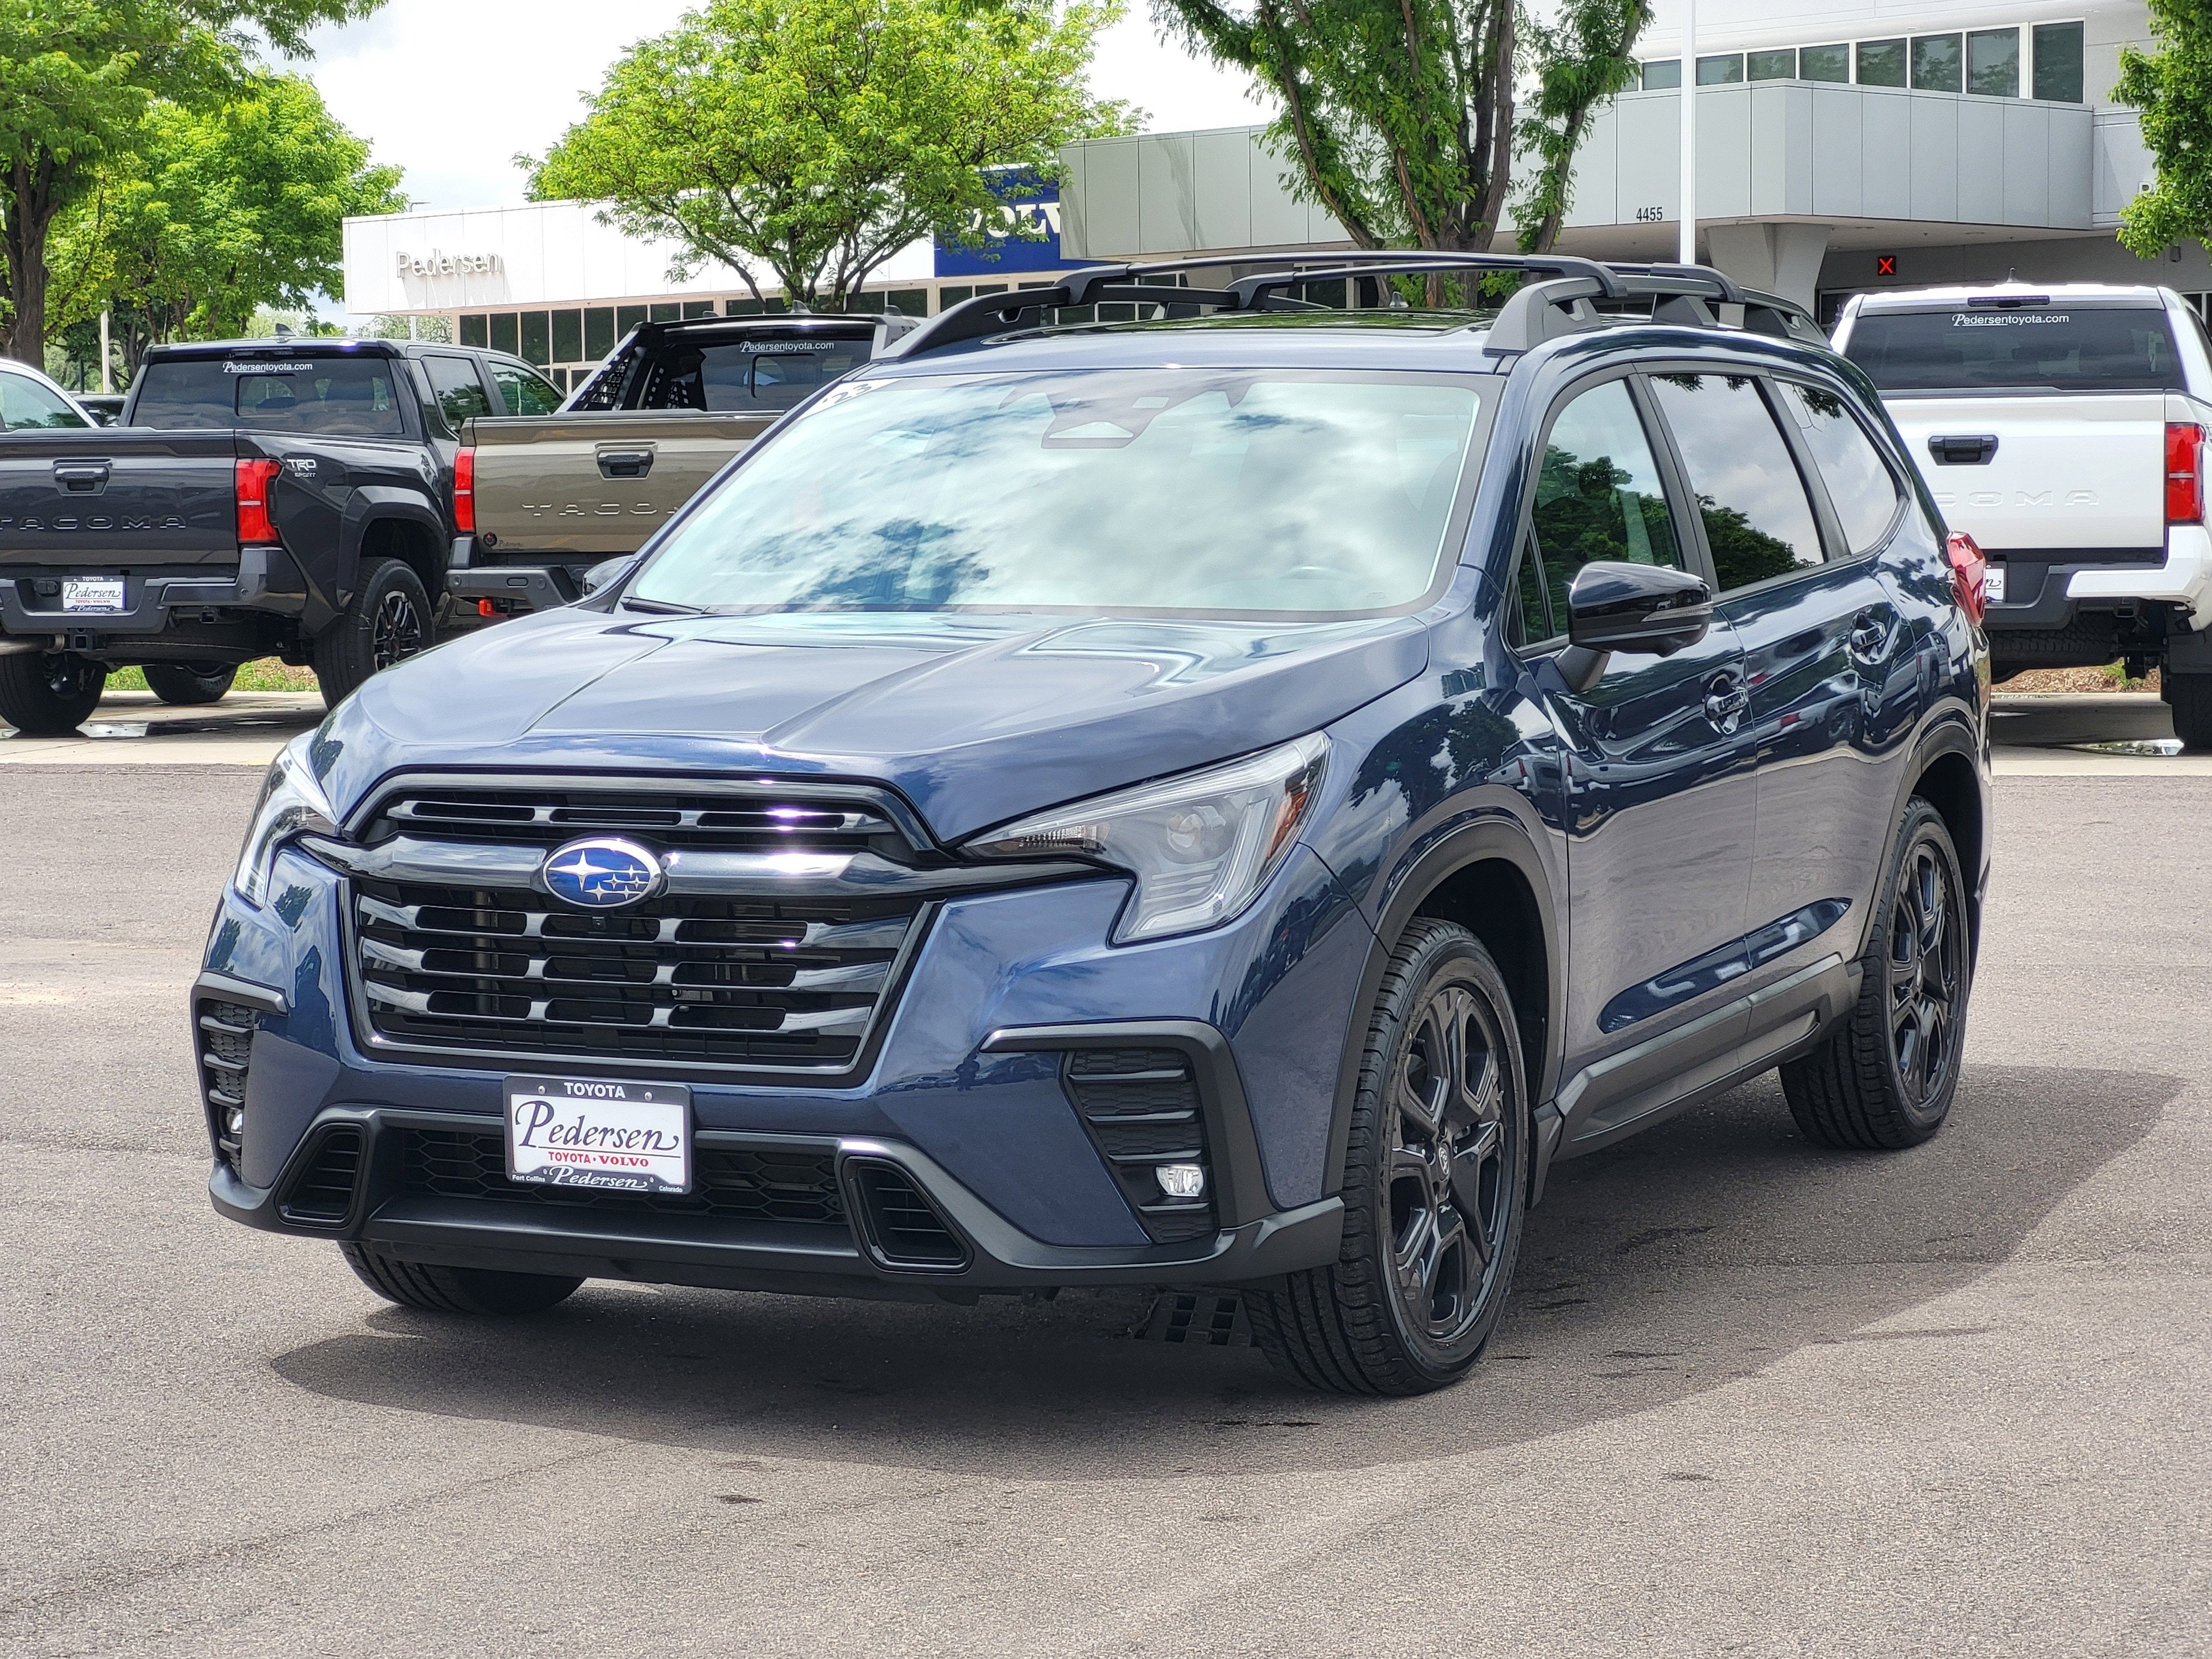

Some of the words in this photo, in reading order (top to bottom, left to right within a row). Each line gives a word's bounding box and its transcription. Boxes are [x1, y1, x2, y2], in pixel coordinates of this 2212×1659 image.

[1636, 207, 1662, 222] 4455
[396, 248, 499, 278] Pedersen
[1952, 314, 2069, 326] Pedersentoyota.com
[739, 341, 834, 352] Pedersentoyota.com
[222, 361, 313, 373] Pedersentoyota.com
[286, 459, 316, 471] TRD
[1933, 490, 2099, 507] COMA
[65, 583, 121, 599] Pedersen
[564, 1082, 626, 1098] TOYOTA
[515, 1100, 680, 1151] Pedersen
[548, 1151, 591, 1164] TOYOTA
[599, 1155, 649, 1167] VOLVO
[549, 1165, 648, 1188] Pedersen
